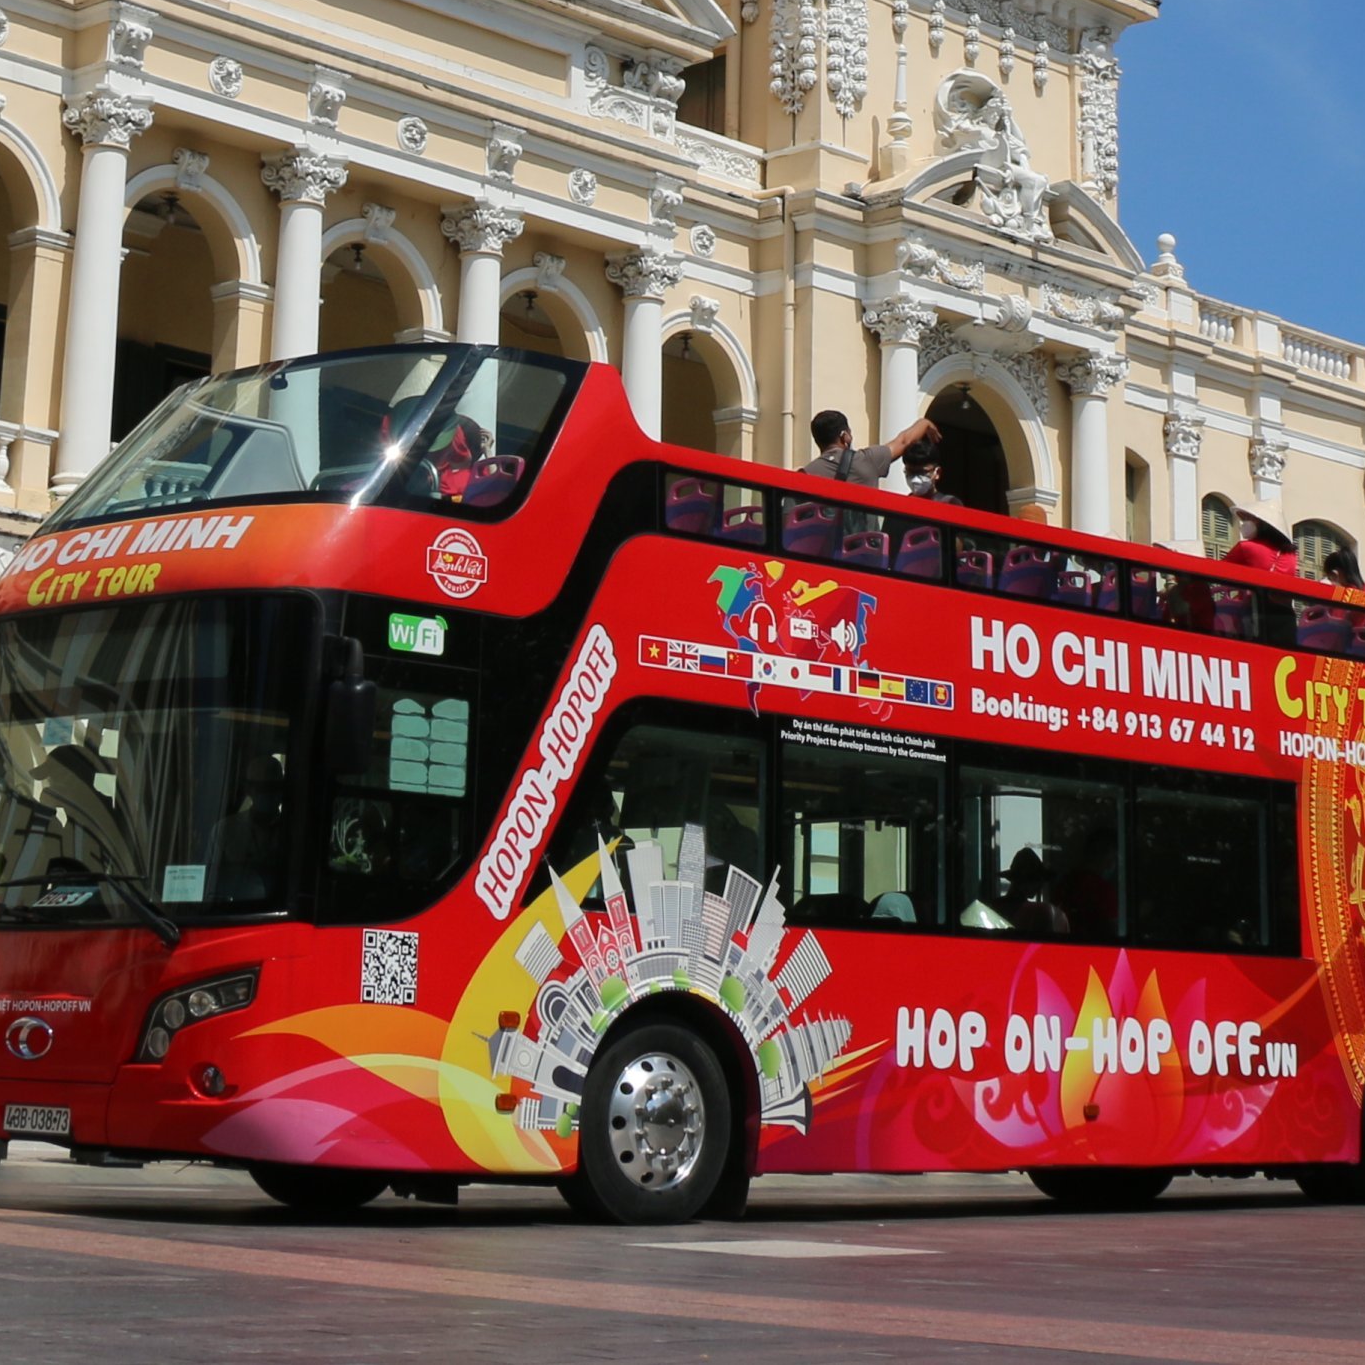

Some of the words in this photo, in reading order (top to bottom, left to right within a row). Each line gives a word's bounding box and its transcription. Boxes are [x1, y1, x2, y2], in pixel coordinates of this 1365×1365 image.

[8, 538, 58, 577] HO
[56, 524, 134, 566] CHI
[126, 515, 255, 556] MINH
[93, 562, 162, 597] TOUR
[970, 615, 1041, 679] HO
[1051, 631, 1131, 694] CHI
[1141, 645, 1252, 712] MINH
[780, 730, 805, 743] Priority
[805, 733, 830, 746] Project
[829, 737, 838, 747] to
[837, 739, 864, 752] develop
[863, 742, 889, 754] tourism
[888, 746, 897, 758] by
[897, 747, 909, 758] the
[908, 750, 947, 763] Government
[971, 687, 1069, 732] Booking:
[1077, 706, 1120, 734] +84
[1124, 711, 1163, 740] 913
[1169, 717, 1196, 744] 67
[1200, 722, 1226, 748] 44
[1232, 726, 1256, 752] 12
[481, 634, 612, 910] HOPON-HOPOFF
[11, 999, 77, 1012] HOPON-HOPOFF
[78, 1000, 92, 1012] VN
[895, 1005, 988, 1072] HOP
